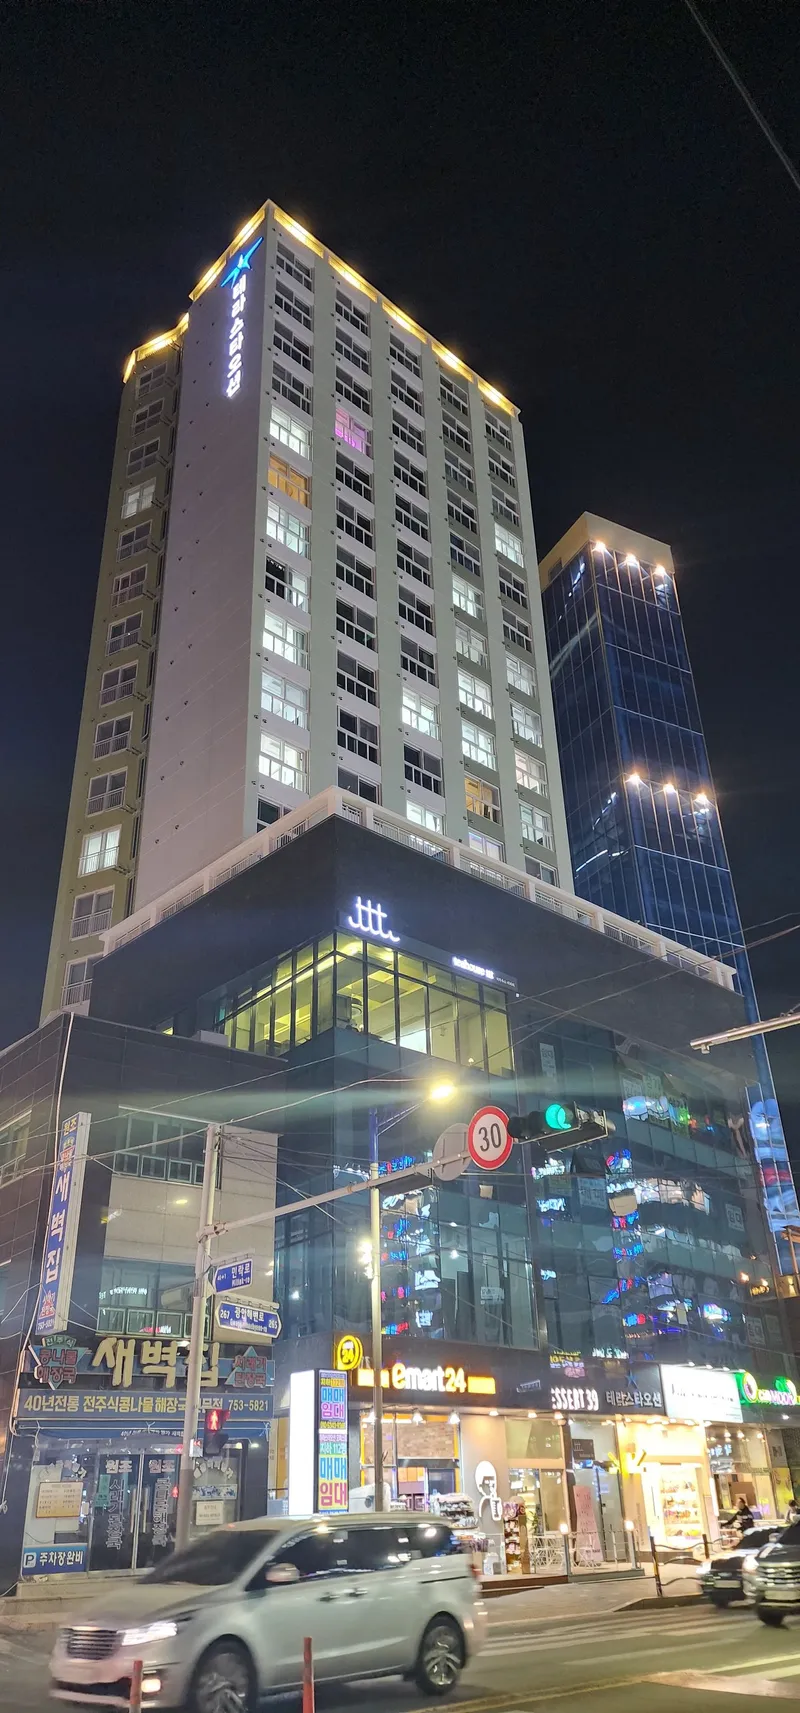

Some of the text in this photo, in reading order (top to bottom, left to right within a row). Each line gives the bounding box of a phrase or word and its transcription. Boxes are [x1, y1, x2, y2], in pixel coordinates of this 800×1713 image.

[478, 1123, 502, 1152] 30
[231, 1263, 251, 1279] 민락로
[220, 1309, 230, 1320] 267
[234, 1306, 265, 1323] 광안해변로
[268, 1319, 278, 1330] 265
[45, 1336, 76, 1348] 전주식
[92, 1337, 220, 1388] 새벽집
[341, 1350, 355, 1364] 24
[392, 1362, 467, 1394] emart24
[321, 1387, 345, 1402] 매매
[585, 1389, 599, 1411] 39
[24, 1395, 79, 1412] 40년전통
[228, 1399, 269, 1412] 753-5821
[321, 1402, 345, 1418] 임대
[106, 1459, 133, 1474] 원조
[149, 1459, 176, 1474] 원조
[319, 1457, 347, 1481] 매매
[319, 1482, 347, 1507] 임대
[25, 1554, 35, 1566] P
[39, 1551, 84, 1567] 주차장완비
